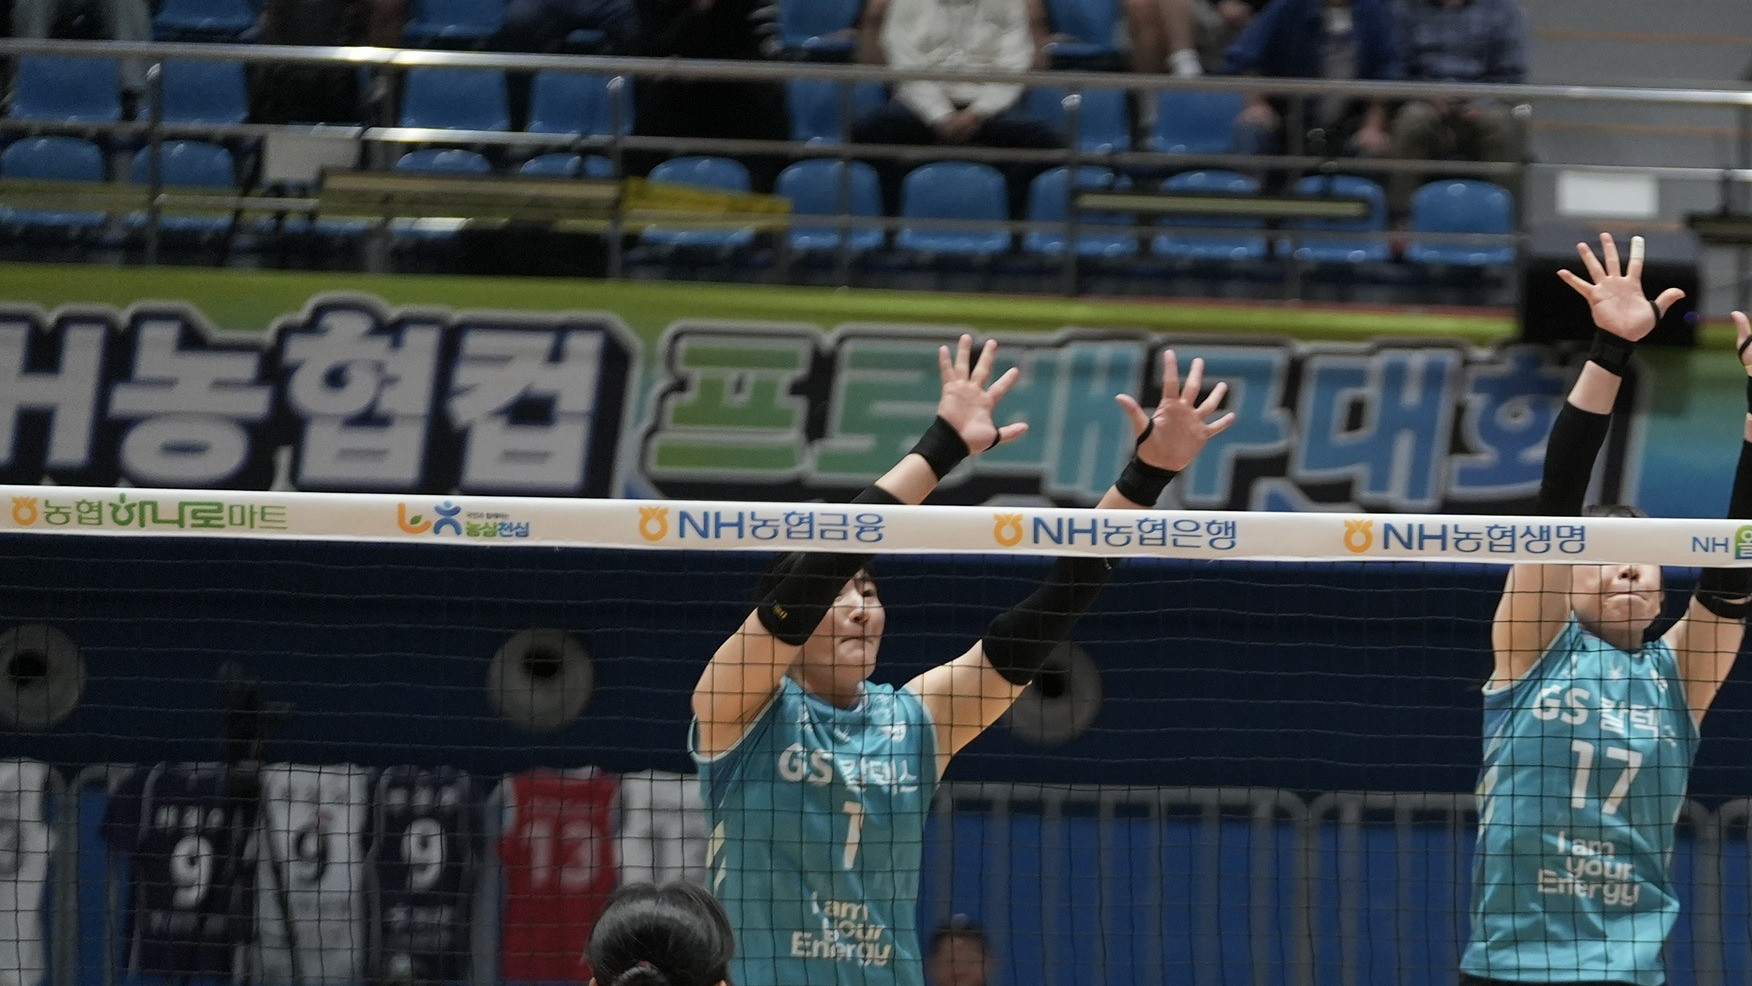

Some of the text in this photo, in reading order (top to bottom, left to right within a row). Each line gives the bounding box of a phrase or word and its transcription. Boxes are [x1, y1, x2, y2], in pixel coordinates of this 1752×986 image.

[678, 511, 886, 543] NH농협금융
[1032, 516, 1238, 550] NH농협은행
[1383, 523, 1587, 555] NH농협생명
[1532, 685, 1590, 726] GS
[778, 742, 833, 785] GS
[1571, 739, 1643, 815] 17
[402, 817, 448, 890] 9
[1571, 838, 1615, 860] am
[1566, 857, 1634, 880] your
[1537, 869, 1641, 906] Energy
[824, 899, 868, 920] am
[790, 930, 892, 966] Energy
